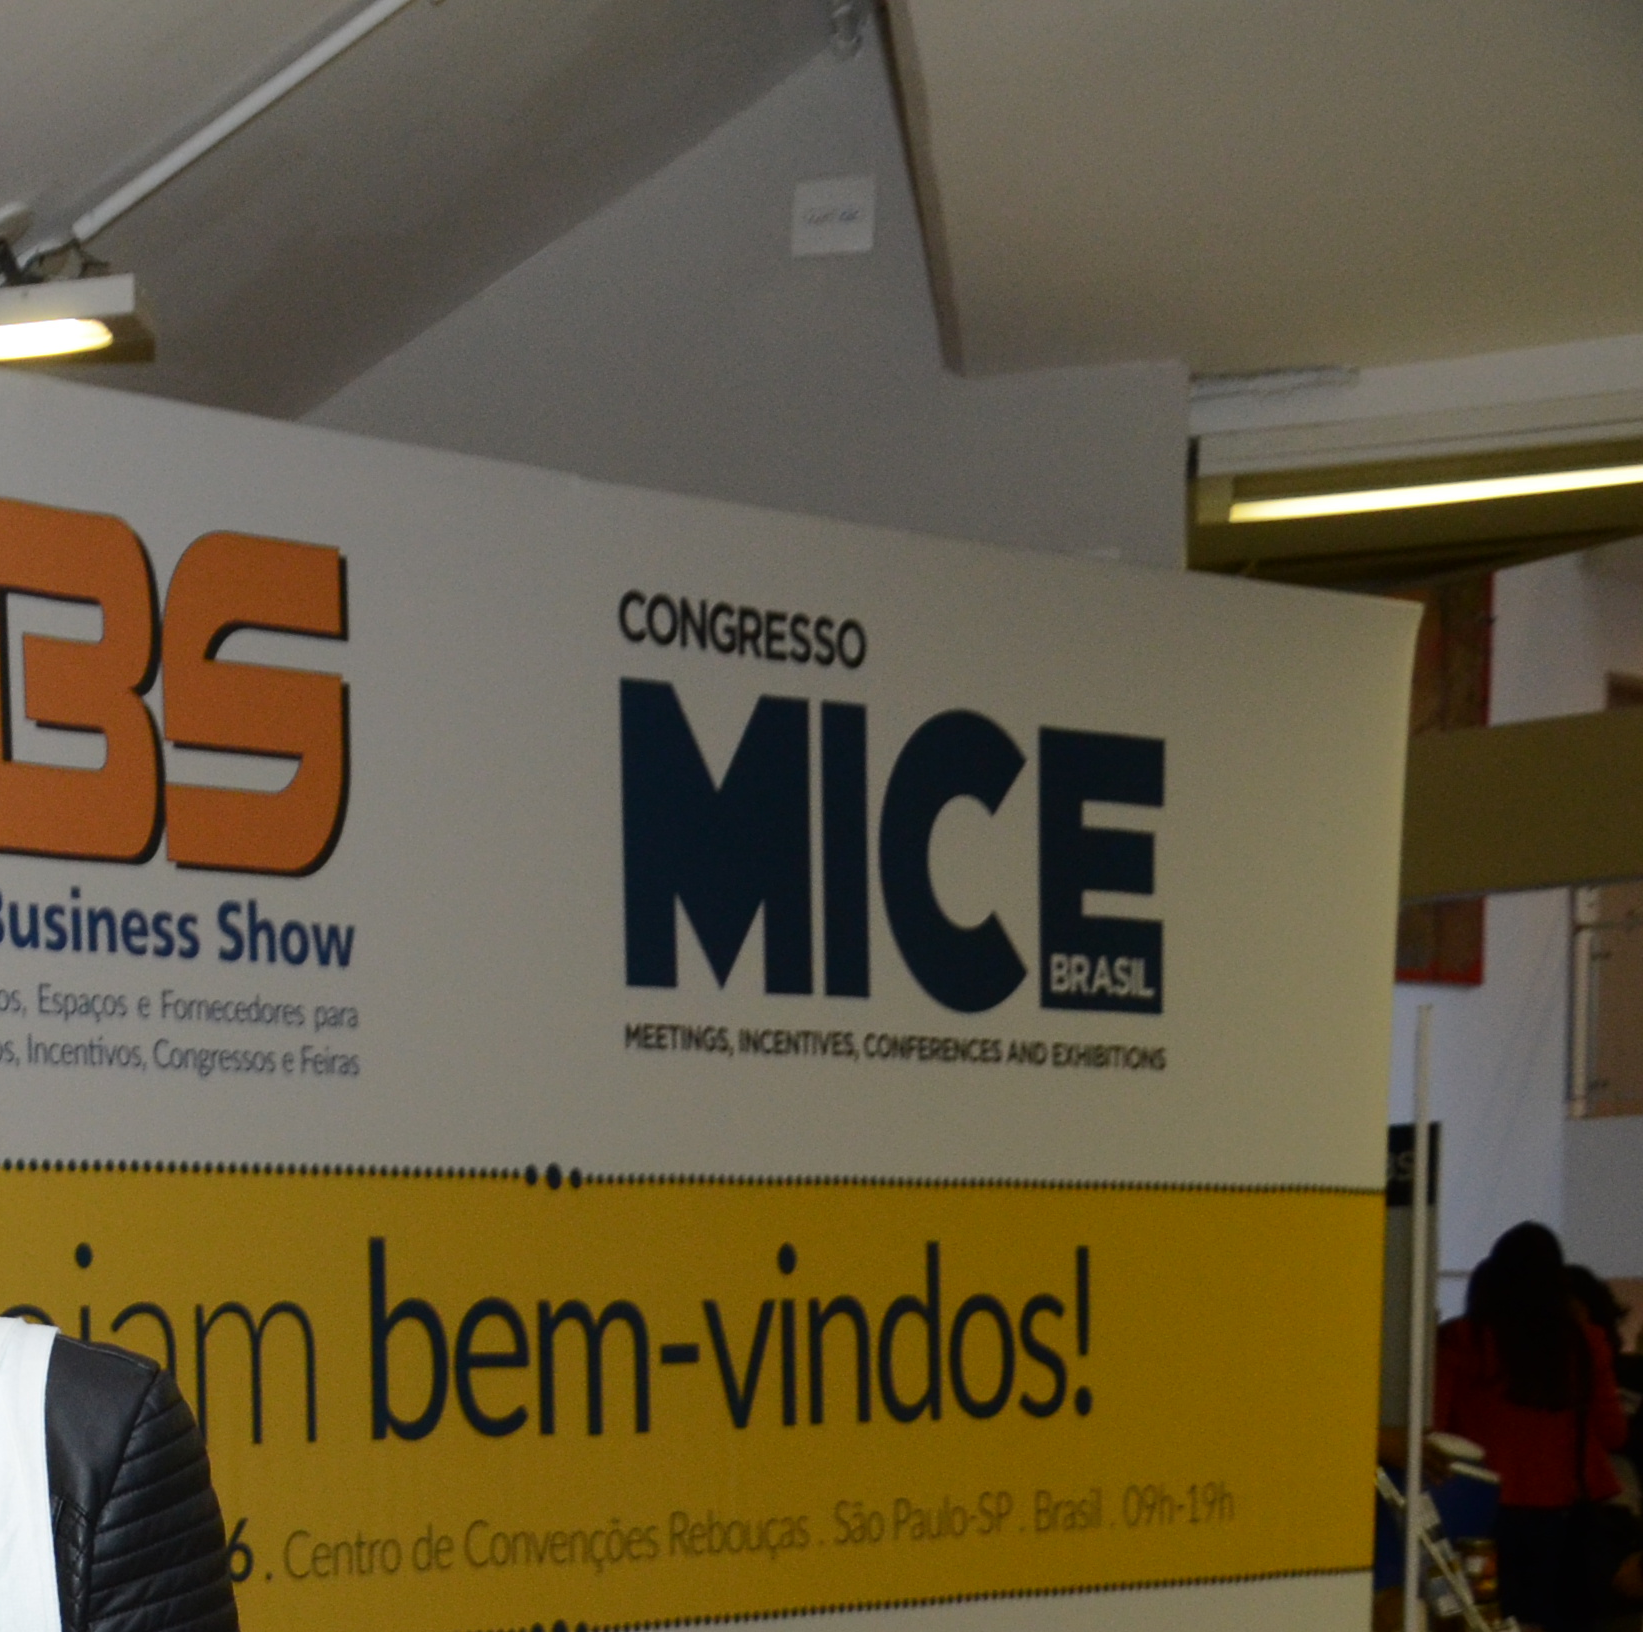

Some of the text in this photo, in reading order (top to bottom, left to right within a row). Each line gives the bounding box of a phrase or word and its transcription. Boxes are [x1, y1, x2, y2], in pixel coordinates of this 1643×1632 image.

[618, 589, 868, 671] CONGRESSO
[620, 677, 1166, 1015] MICE
[217, 899, 355, 968] Show
[37, 982, 128, 1023] Espaços
[137, 994, 151, 1018] e
[160, 989, 305, 1027] Fornecedores
[314, 1002, 359, 1033] para
[1049, 953, 1155, 998] BRASIL
[27, 1032, 147, 1072] Incentivos,
[152, 1038, 277, 1078] Congressos
[282, 1051, 294, 1073] e
[300, 1044, 361, 1077] Feiras
[625, 1023, 1167, 1071] MEETINGS, INCENTIVES, CONFERENCES AND EXHIBITIONS
[368, 1236, 1094, 1443] bem-vindos!
[283, 1529, 403, 1580] Centro
[414, 1523, 454, 1572] de
[465, 1518, 658, 1574] Convenções
[669, 1509, 812, 1559] Rebouças
[833, 1498, 884, 1544] São
[894, 1491, 1015, 1541] Paulo-SP
[1035, 1488, 1104, 1534] Brasil
[1122, 1480, 1237, 1528] 09h-19h
